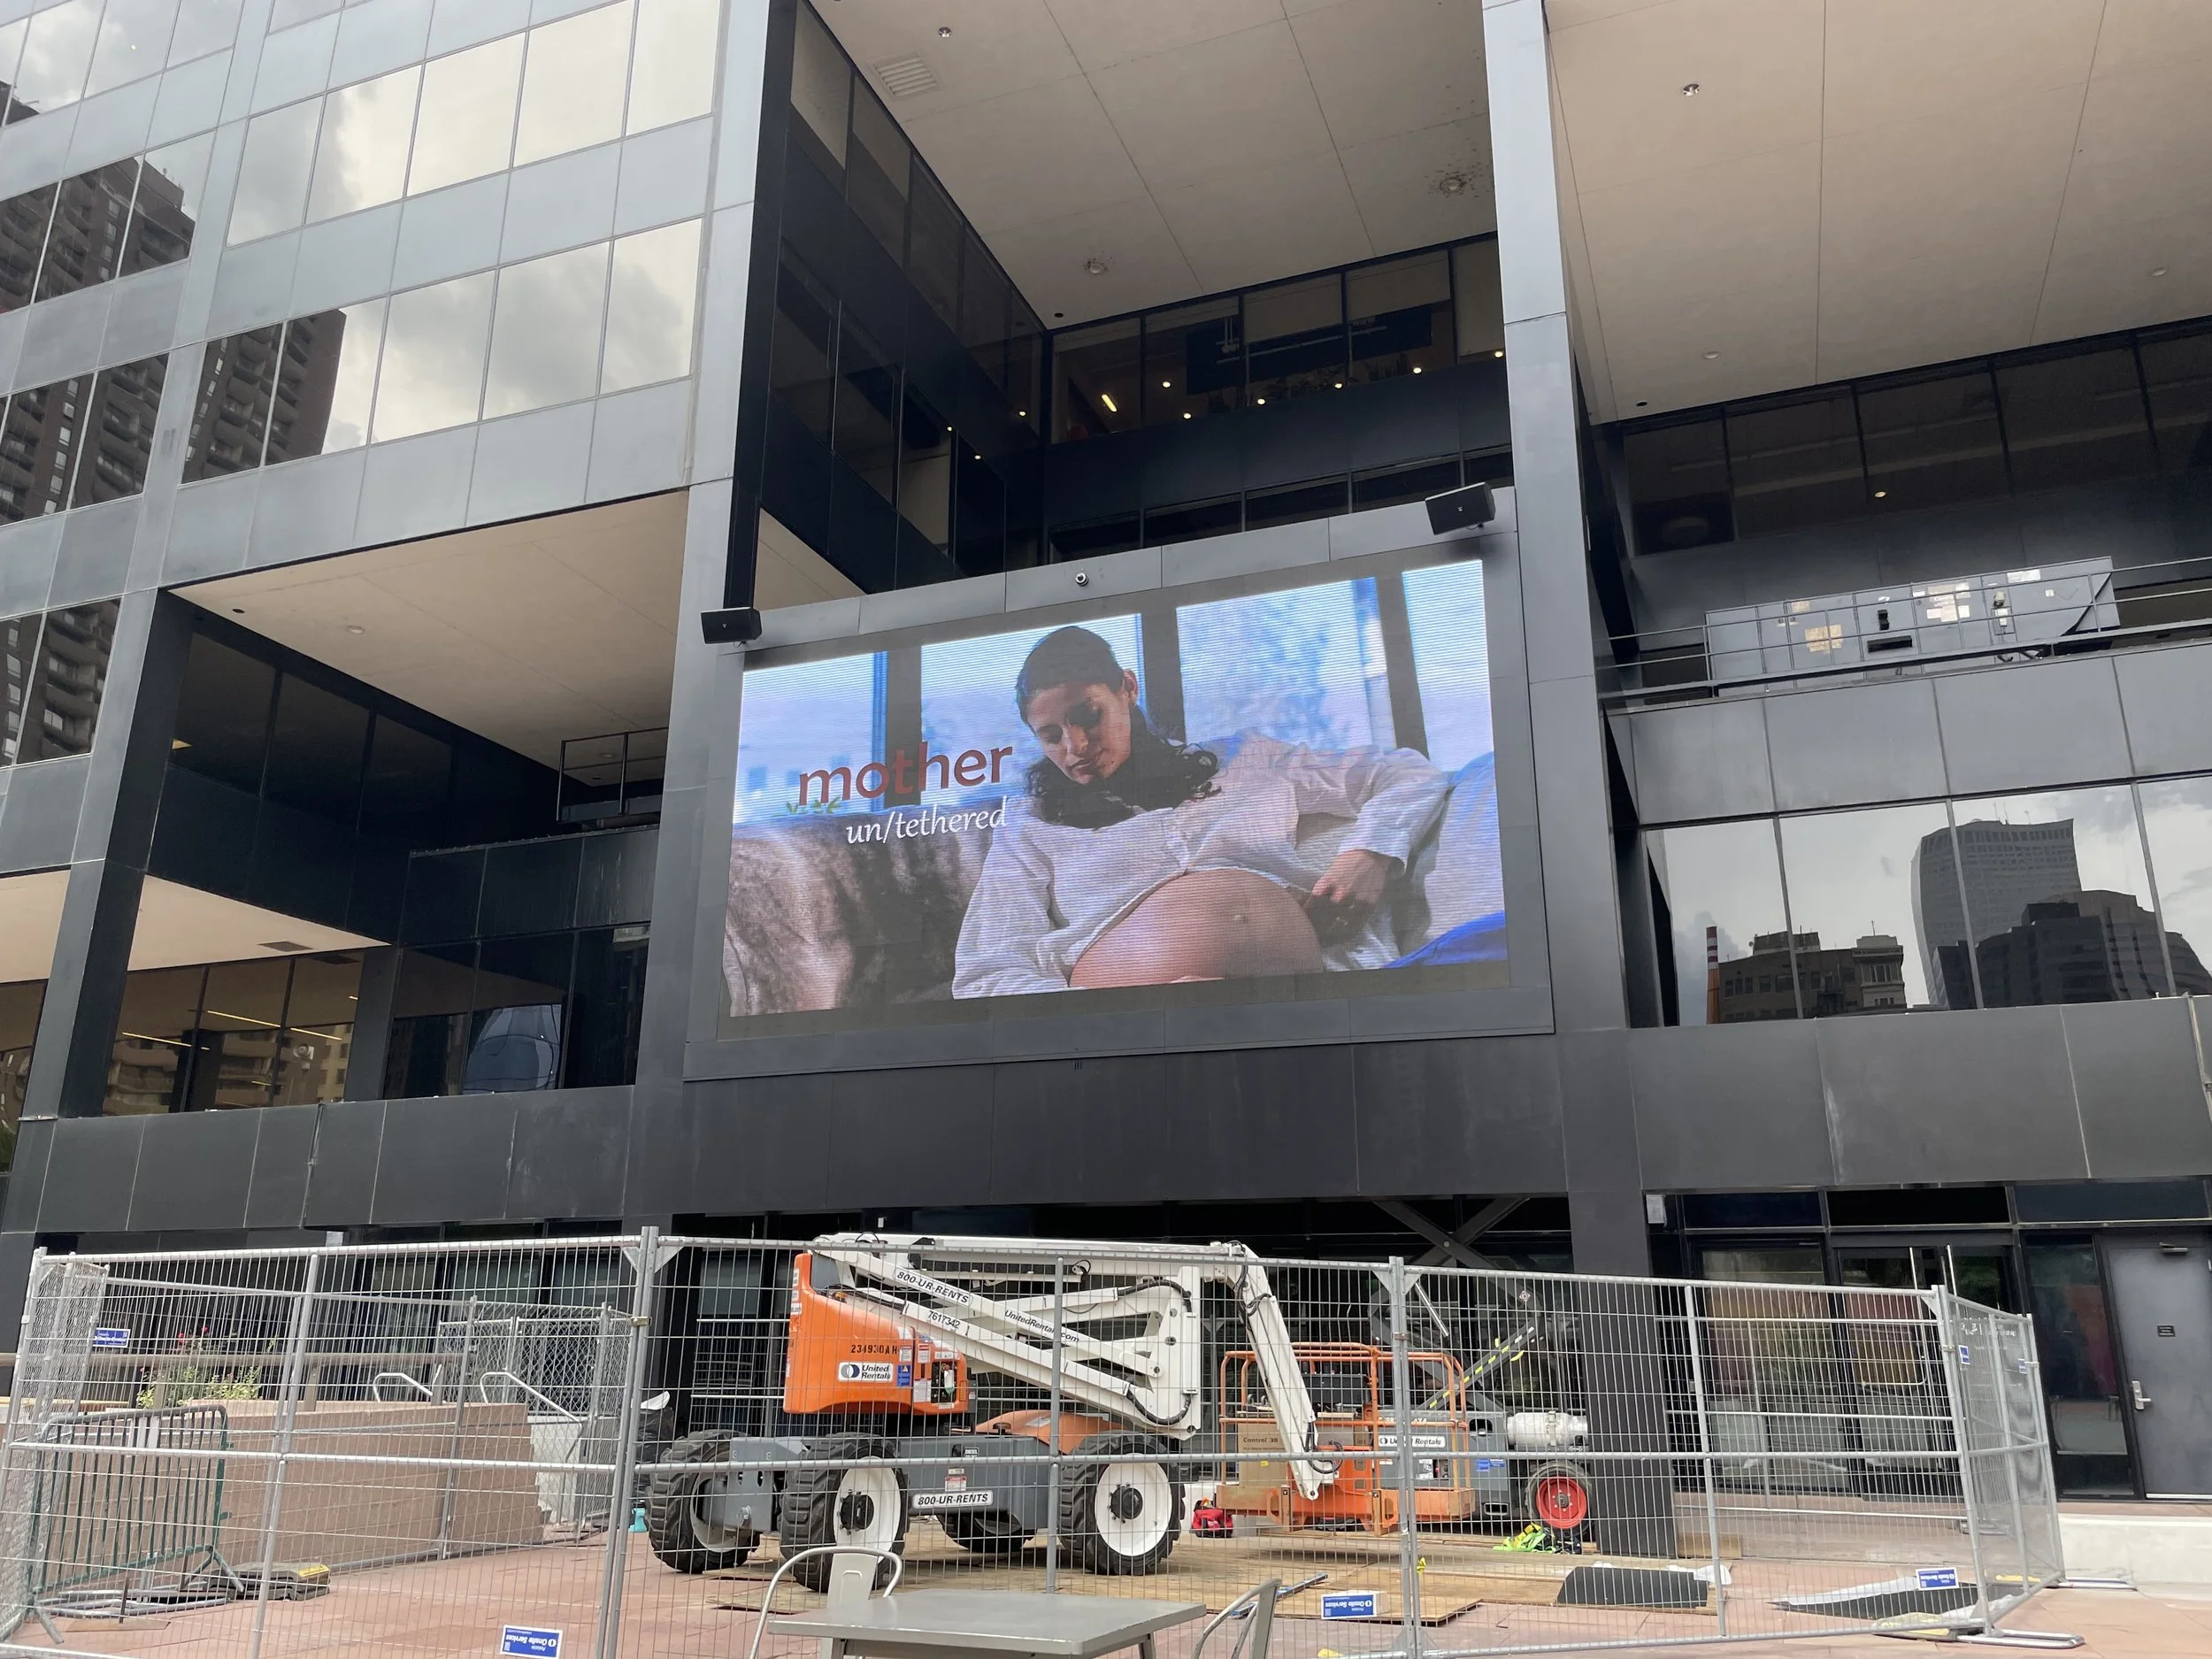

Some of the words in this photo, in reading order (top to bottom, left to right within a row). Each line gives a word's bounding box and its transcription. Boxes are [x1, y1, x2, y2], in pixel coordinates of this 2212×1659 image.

[799, 741, 1013, 806] mother
[846, 795, 1007, 844] un/tethered
[897, 1271, 969, 1303] 800-UR-RENTS
[927, 1310, 961, 1329] 7617342
[918, 1494, 988, 1505] 800-UR-RENTS
[506, 1635, 527, 1644] Services
